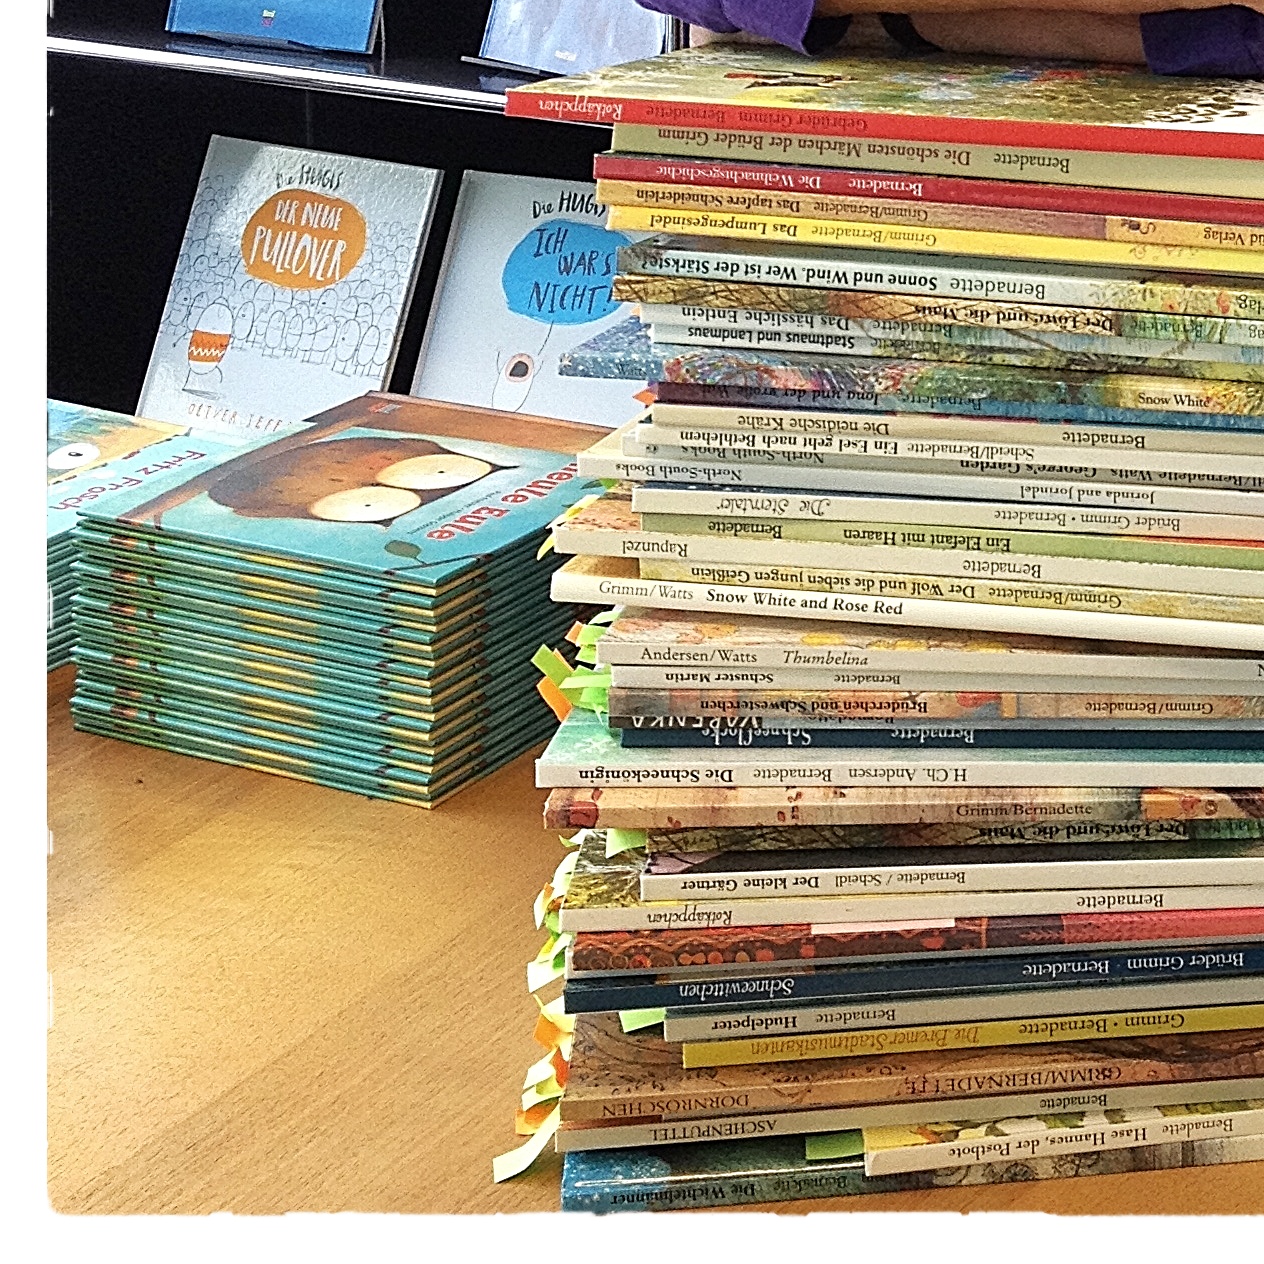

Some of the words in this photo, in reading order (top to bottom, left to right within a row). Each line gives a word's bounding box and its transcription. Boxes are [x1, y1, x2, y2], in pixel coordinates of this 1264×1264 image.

[538, 98, 623, 121] Rotkäppchen
[658, 129, 709, 146] Grimm
[713, 132, 764, 151] Brüder
[768, 136, 793, 153] der
[797, 138, 862, 157] Märchen
[867, 144, 940, 162] schönsten
[944, 149, 971, 166] Die
[656, 166, 794, 188] Weihnachtsgeschichte
[798, 175, 821, 189] Die
[848, 177, 923, 195] Bernadette
[636, 189, 723, 206] Schneiderlein
[727, 194, 774, 212] tapfere
[777, 199, 800, 213] Das
[275, 200, 299, 225] DER
[301, 202, 343, 231] NEUE
[533, 201, 554, 218] Die
[650, 213, 768, 234] Lumpengesindel
[772, 222, 798, 237] Das
[533, 228, 568, 258] ICH
[250, 227, 346, 282] PULLOVER
[641, 256, 710, 276] Stärkste?
[714, 260, 742, 277] der
[745, 262, 763, 278] ist
[767, 264, 797, 280] Wer
[800, 268, 849, 287] Wind.
[853, 271, 883, 287] und
[887, 274, 938, 290] Sonne
[950, 276, 1046, 298] Bernadette
[528, 281, 613, 314] NICHT!
[681, 307, 738, 325] Entlein
[743, 311, 815, 329] hässliche
[819, 316, 850, 331] Das
[737, 415, 786, 434] Krähe
[793, 418, 858, 435] neidische
[863, 420, 890, 436] Die
[134, 449, 207, 476] Fritz
[48, 476, 141, 512] Frosch
[426, 506, 510, 541] Eule
[843, 529, 896, 546] Haaren
[901, 533, 926, 547] mit
[930, 533, 981, 550] Elefant
[985, 537, 1011, 552] Ein
[622, 539, 688, 558] Rapunzel
[707, 589, 747, 607] Snow
[753, 591, 795, 610] White
[799, 596, 828, 611] and
[833, 598, 869, 614] Rose
[874, 601, 903, 616] Red
[579, 766, 699, 785] Schneekönigin
[704, 768, 733, 783] Die
[681, 876, 738, 894] Gärtner
[742, 876, 787, 892] kleine
[791, 876, 819, 890] Der
[679, 977, 794, 1000] Schneewittchen
[712, 1013, 797, 1033] Hudelpeter
[649, 1118, 777, 1143] ASCHENPUTTEL
[1111, 1126, 1147, 1144] Hase
[1162, 1117, 1233, 1137] Bernadette
[1014, 1136, 1040, 1152] der
[1045, 1129, 1105, 1148] Hannes,
[948, 1141, 1010, 1161] Postbote
